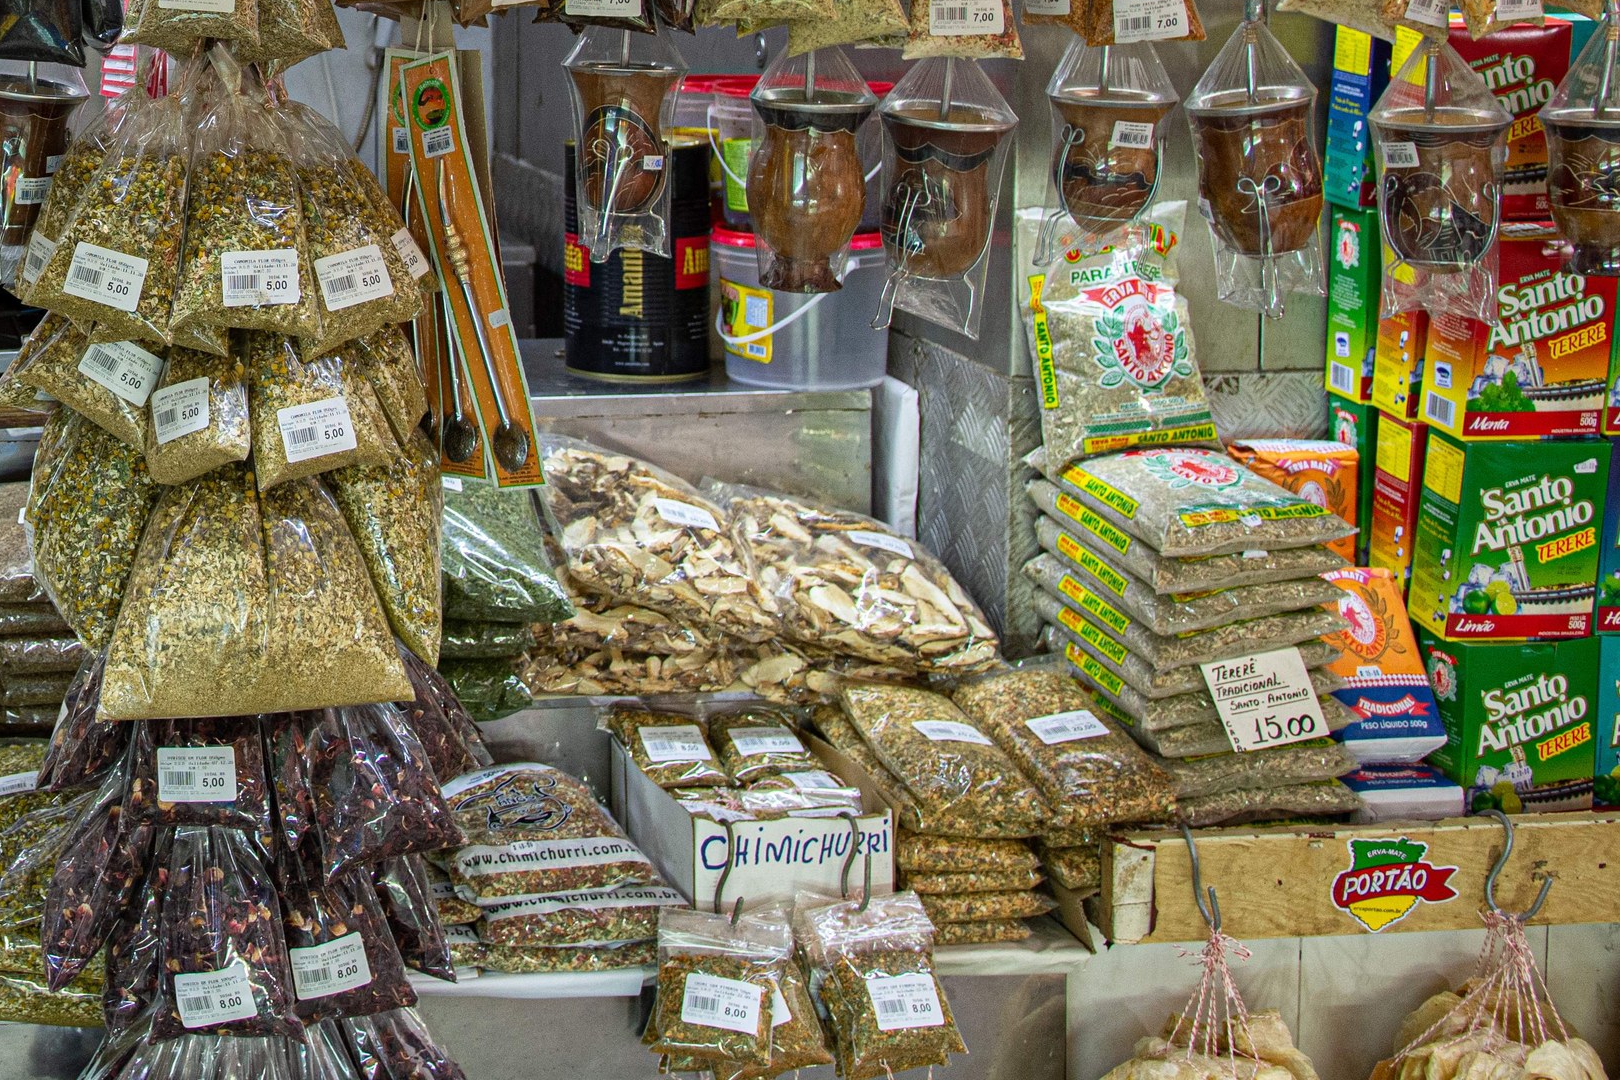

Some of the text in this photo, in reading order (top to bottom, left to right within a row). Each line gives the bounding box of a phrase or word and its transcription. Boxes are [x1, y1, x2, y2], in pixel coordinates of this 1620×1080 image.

[972, 12, 994, 23] 7,00
[1156, 17, 1178, 28] 7,00
[266, 280, 287, 291] 5,00
[362, 274, 381, 286] 5,00
[107, 281, 129, 296] 5,00
[1498, 272, 1585, 317] Santo
[1488, 295, 1604, 352] Antonio
[1550, 323, 1606, 358] TERERE
[1036, 321, 1055, 404] SANTO ANTONIO
[121, 373, 142, 390] 5,00
[182, 407, 199, 420] 5,00
[1469, 417, 1509, 430] Menta
[1580, 417, 1597, 426] 500g
[324, 428, 345, 440] 5,00
[1138, 425, 1214, 442] SANTO ANTONIO
[1311, 460, 1334, 472] MATE
[1520, 474, 1536, 484] MATE
[1106, 490, 1135, 514] ANTONIO
[1483, 475, 1573, 520] Santo
[1080, 511, 1127, 550] SANTO ANTONIO
[1471, 499, 1594, 556] Antonio
[1538, 529, 1595, 561] TERERE
[1456, 620, 1495, 633] Limão
[1568, 619, 1585, 630] 500g
[1520, 675, 1534, 684] MATE
[1230, 688, 1309, 711] SANTO ANTONIO
[1482, 673, 1569, 723] Santo
[1359, 697, 1414, 715] TRADICIONAL
[1252, 713, 1316, 745] 15,00
[1361, 720, 1428, 730] PESO LÍQUIDO 500g
[1477, 694, 1587, 758] Antonio
[1538, 724, 1590, 759] TERERE
[202, 777, 225, 788] 5,00
[1367, 846, 1407, 861] ERVA-MATE
[1343, 863, 1428, 895] PORTÃO
[337, 964, 358, 978] 8,00
[219, 996, 242, 1009] 8,00
[724, 1007, 746, 1019] 8,00
